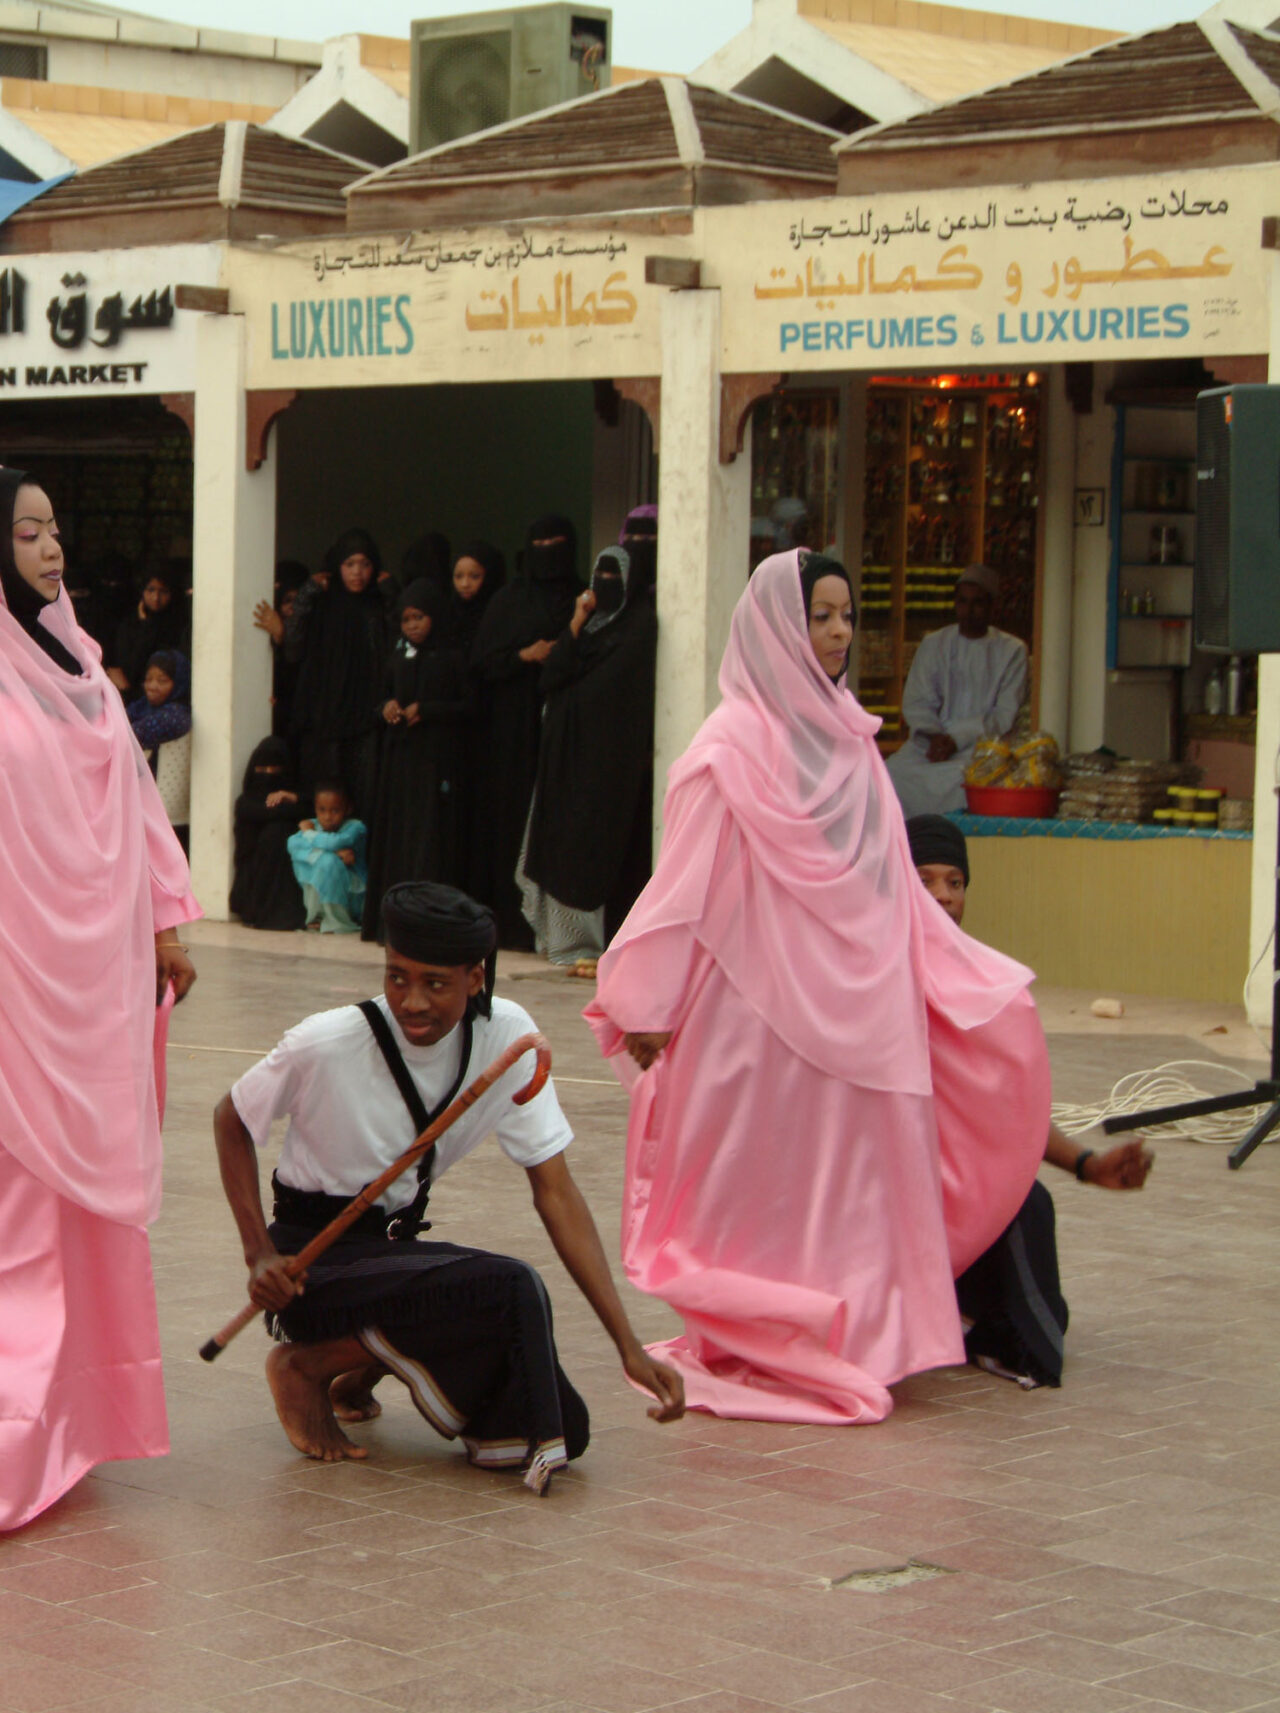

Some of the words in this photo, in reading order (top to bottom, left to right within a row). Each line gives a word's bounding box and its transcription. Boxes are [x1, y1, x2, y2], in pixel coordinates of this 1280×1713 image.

[1004, 206, 1058, 232] بنت
[1064, 197, 1132, 230] رضية
[1140, 190, 1228, 217] محلات
[790, 209, 873, 249] للتجارة
[872, 206, 931, 244] عاشور
[314, 243, 380, 282] للتجارة
[484, 246, 503, 268] بن
[557, 233, 627, 262] مؤسسة
[1041, 234, 1234, 300] عطور
[753, 244, 983, 311] كماليات
[1004, 264, 1022, 305] و
[46, 271, 175, 349] سوق
[271, 294, 414, 359] LUXURIES
[465, 270, 637, 347] كماليات
[780, 315, 957, 352] PERFUMES
[970, 324, 984, 346] &
[997, 304, 1190, 344] LUXURIES
[25, 362, 148, 387] MARKET
